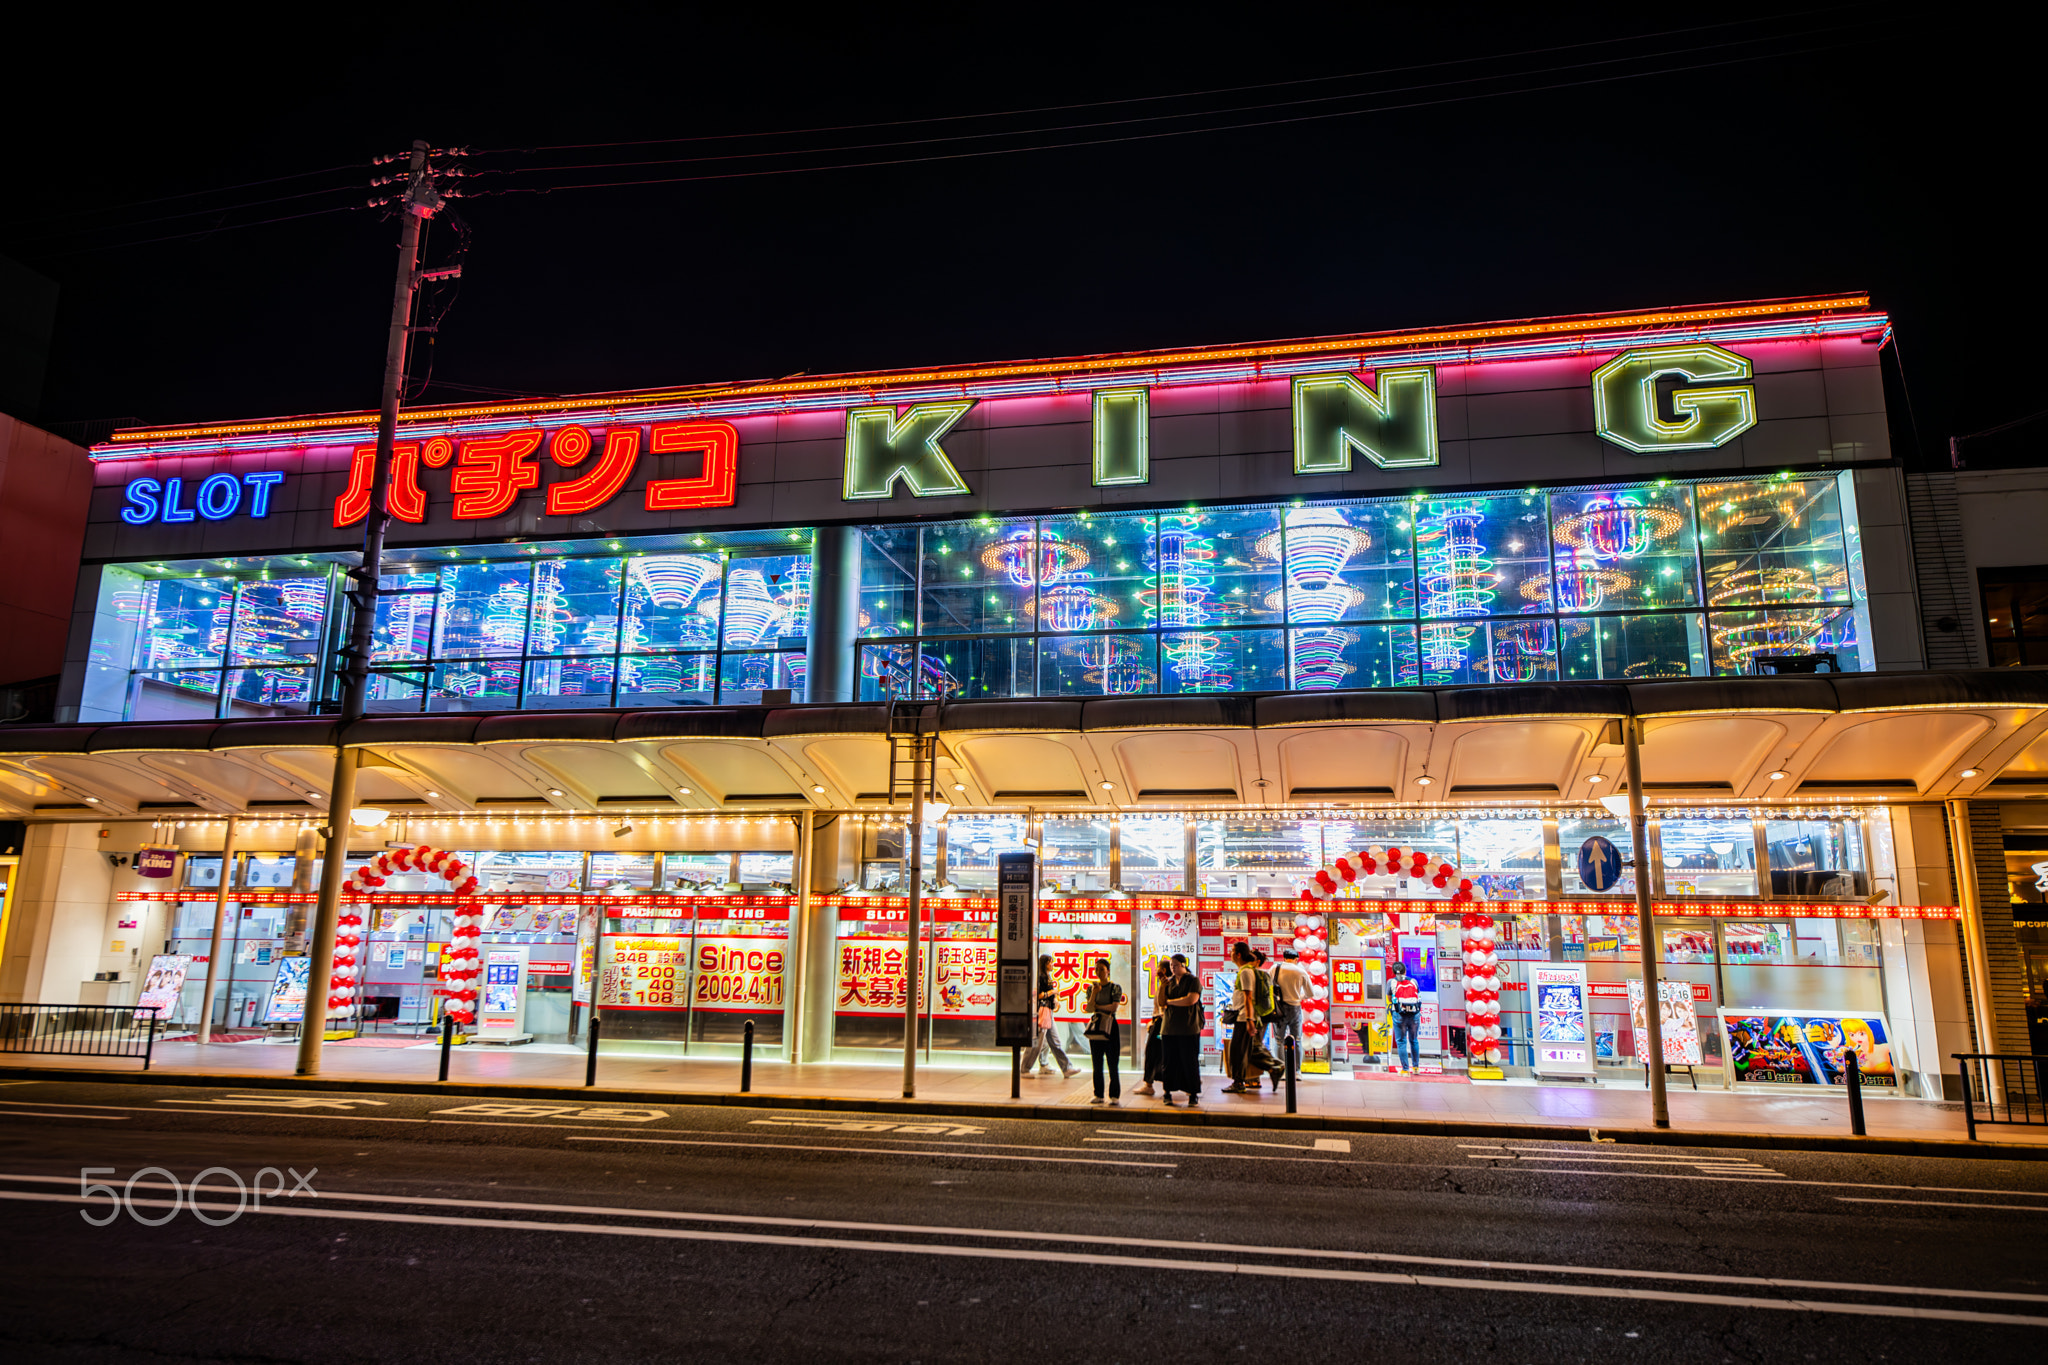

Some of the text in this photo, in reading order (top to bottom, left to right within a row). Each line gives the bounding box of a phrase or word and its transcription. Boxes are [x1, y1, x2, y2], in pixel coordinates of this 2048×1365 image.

[842, 342, 1759, 502] KING
[333, 421, 739, 529] パチンコ
[120, 470, 285, 525] SLOT
[141, 859, 173, 869] KING
[621, 907, 682, 918] PACHINKO
[727, 908, 765, 919] KING
[866, 910, 907, 920] SLOT
[1048, 912, 1117, 923] PACHINKO
[699, 944, 785, 973] Since
[1339, 962, 1356, 972] 本日
[1334, 972, 1362, 983] 10:00
[697, 975, 784, 1004] 2002.4.11
[1337, 983, 1360, 993] OPEN
[1344, 1010, 1376, 1020] KING
